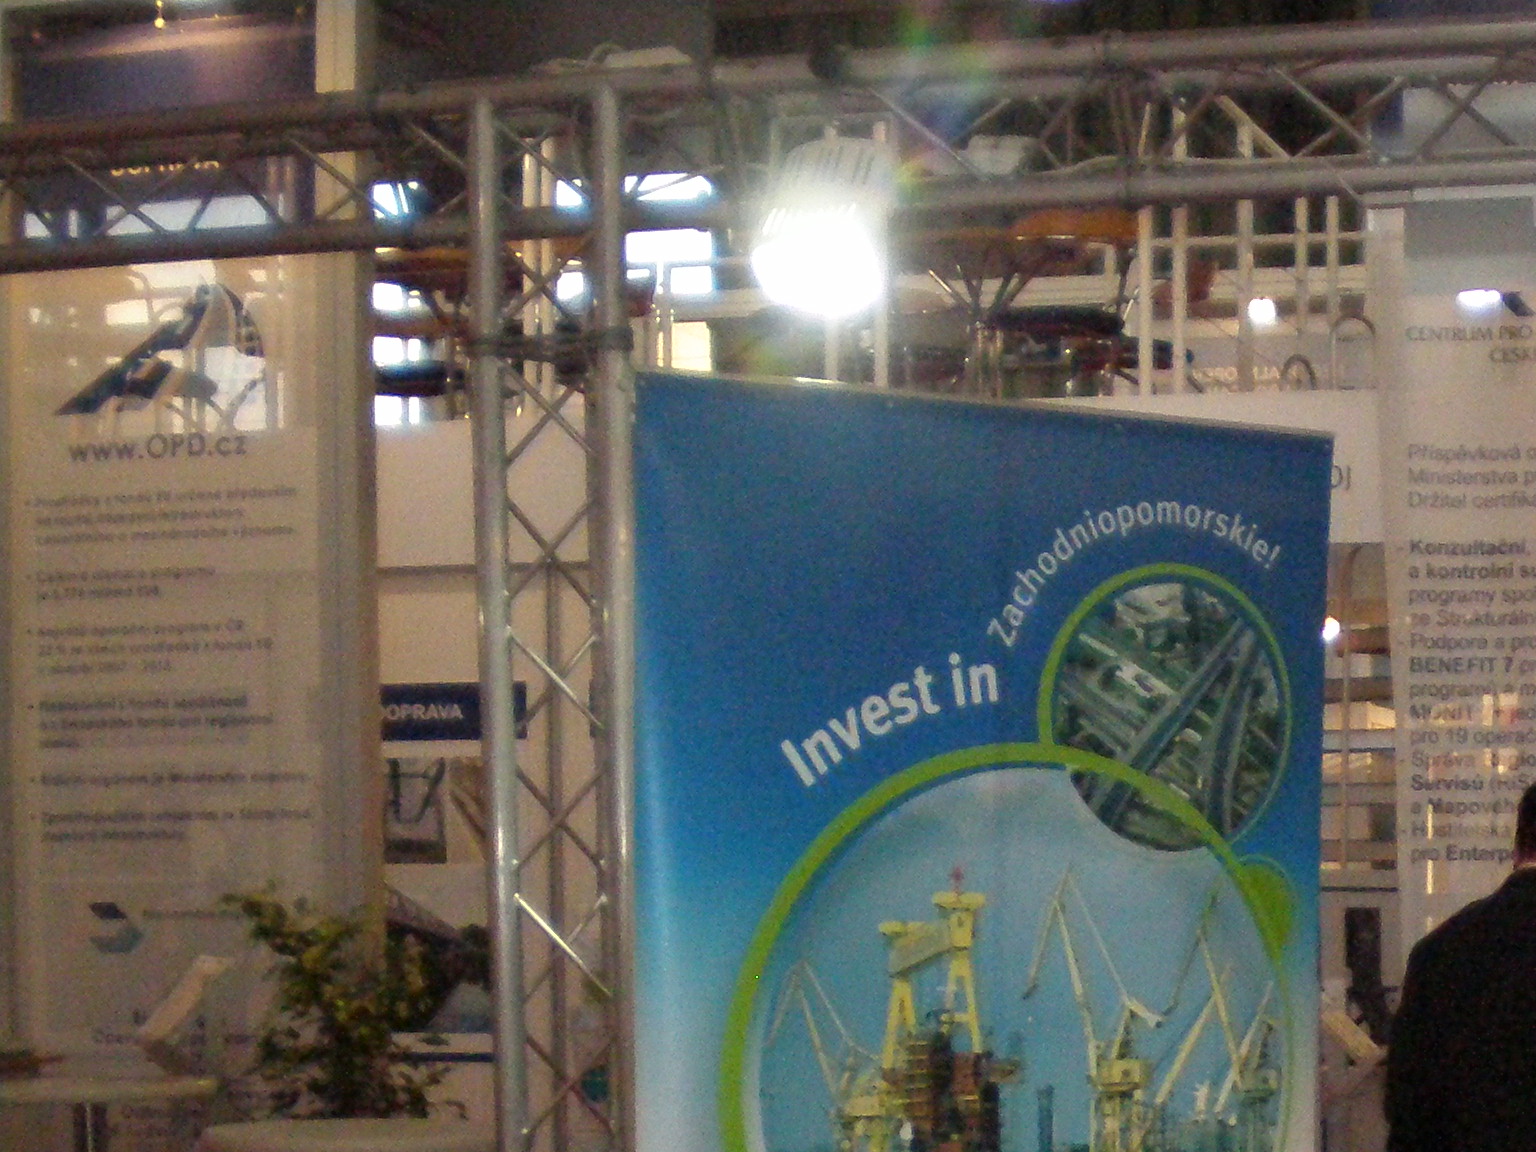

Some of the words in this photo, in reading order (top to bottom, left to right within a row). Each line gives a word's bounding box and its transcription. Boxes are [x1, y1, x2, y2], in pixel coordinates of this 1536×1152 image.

[69, 432, 248, 462] www.OPD.cz
[1408, 466, 1518, 485] Ministerstva
[987, 500, 1281, 648] Zachodniopomorskie!
[1408, 567, 1419, 580] a
[1408, 588, 1496, 607] programy
[1410, 656, 1498, 674] BENEFIT
[382, 703, 464, 720] OPRAVA
[781, 665, 941, 787] Invest
[949, 652, 999, 707] in
